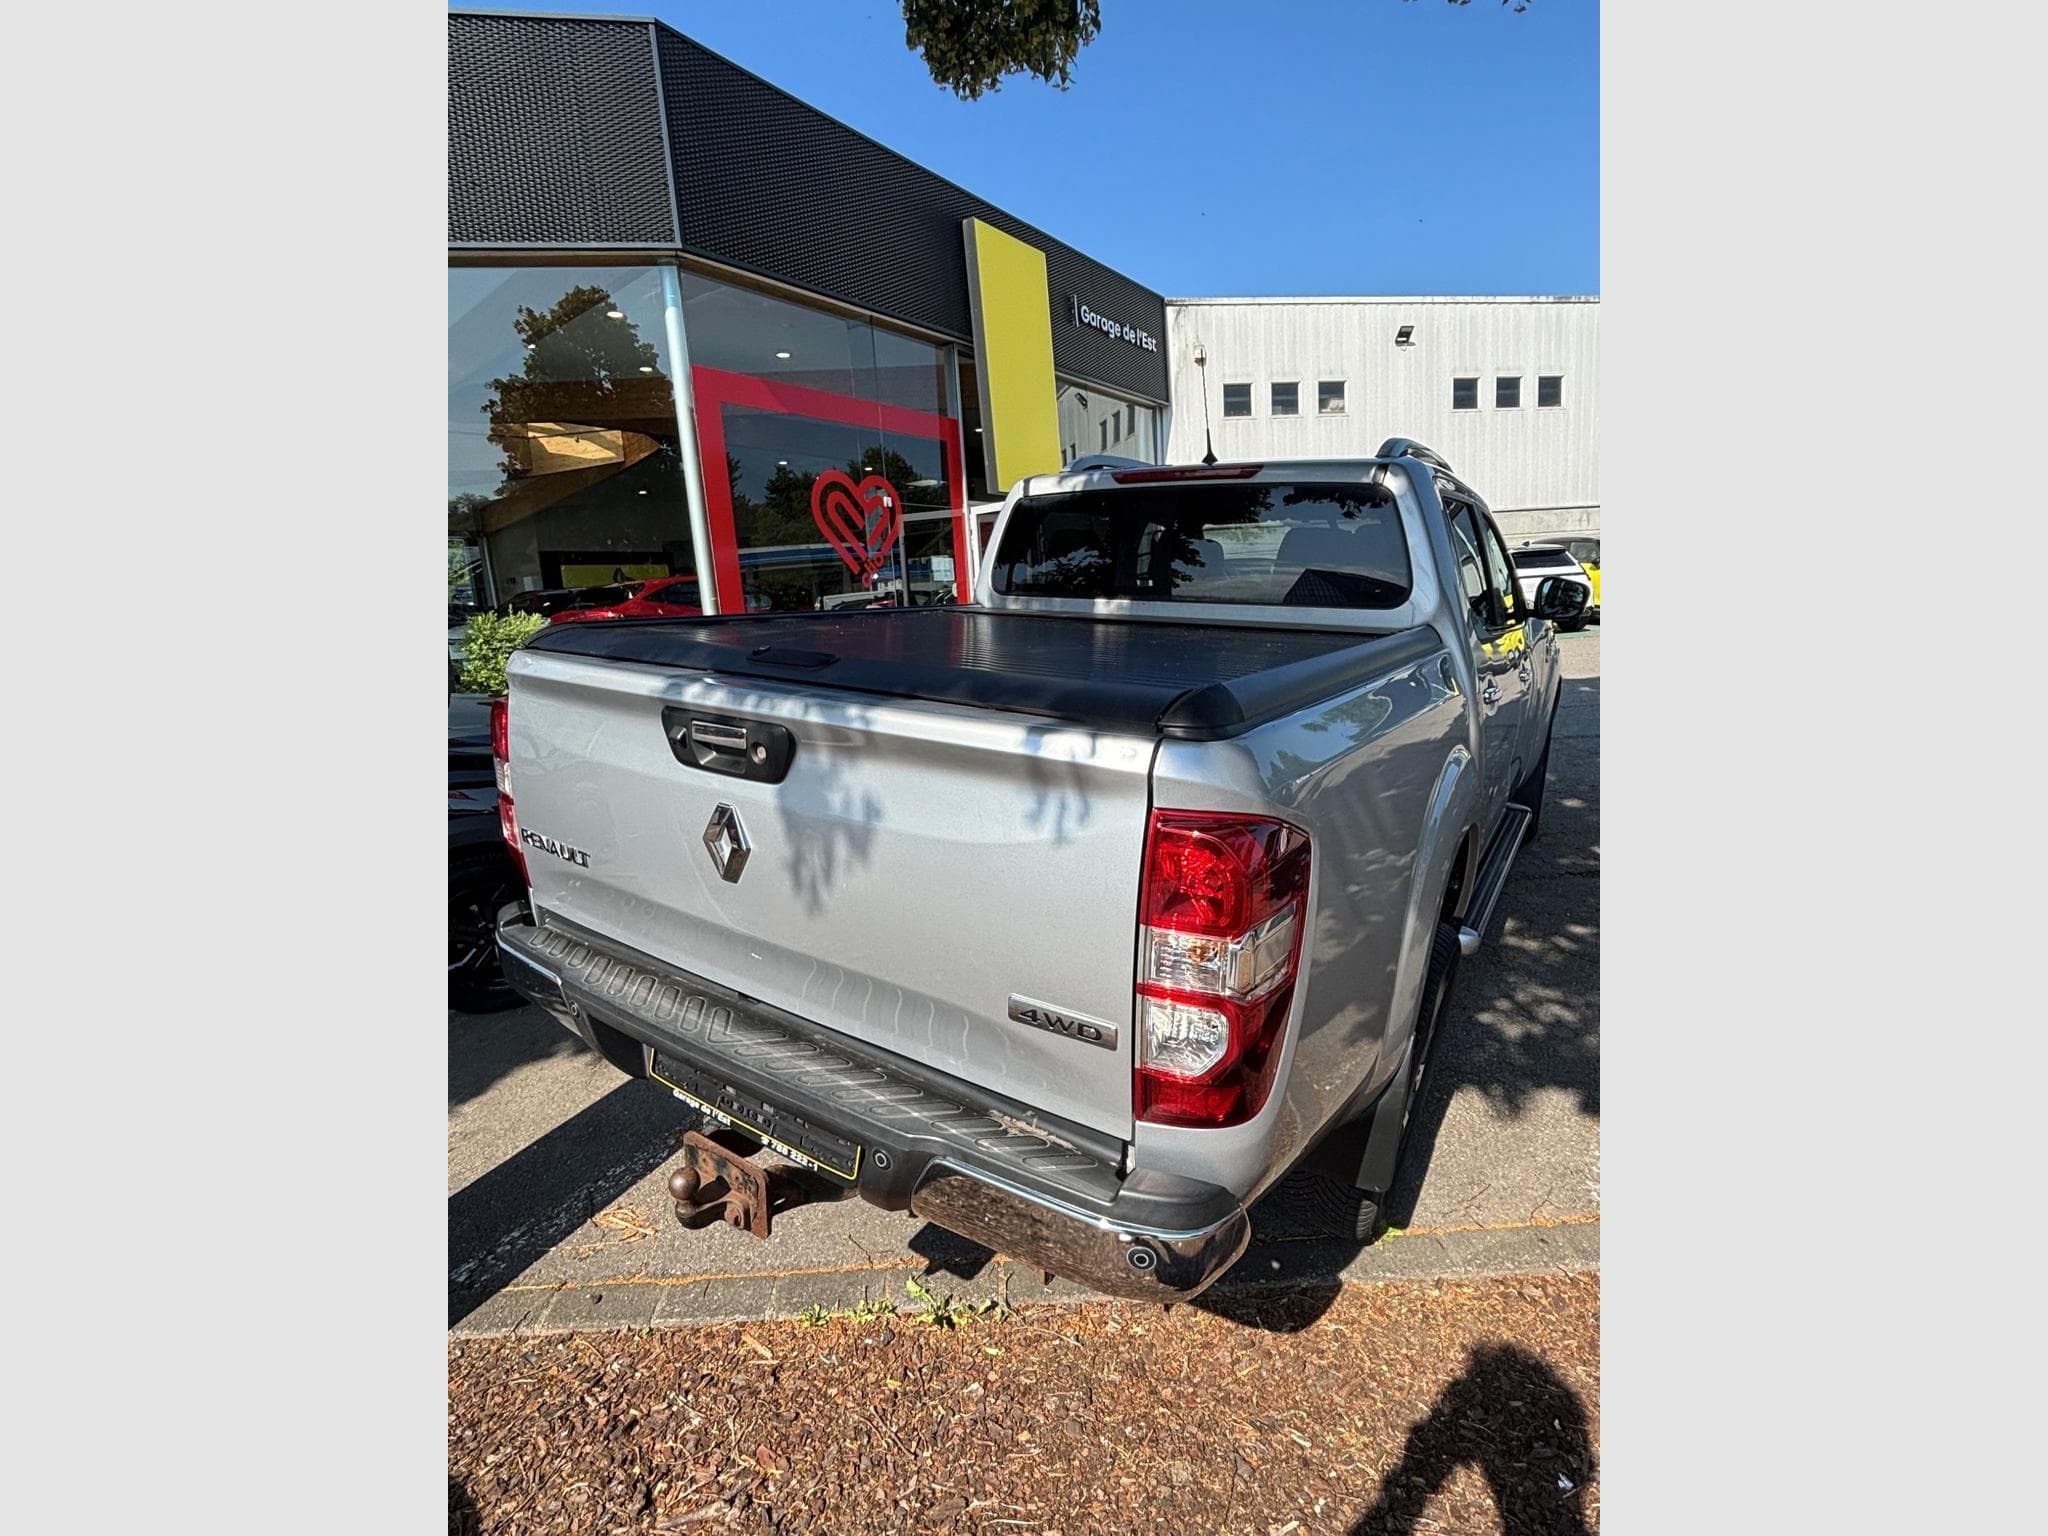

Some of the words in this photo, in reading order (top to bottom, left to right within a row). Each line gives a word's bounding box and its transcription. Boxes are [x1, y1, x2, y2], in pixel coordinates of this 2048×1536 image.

[1080, 305, 1121, 338] Garage
[1122, 324, 1136, 344] de
[1136, 327, 1157, 352] l'Est
[520, 827, 591, 869] RENAULT
[1019, 1009, 1103, 1041] 4WD
[672, 1089, 700, 1109] Garage
[700, 1104, 711, 1115] de
